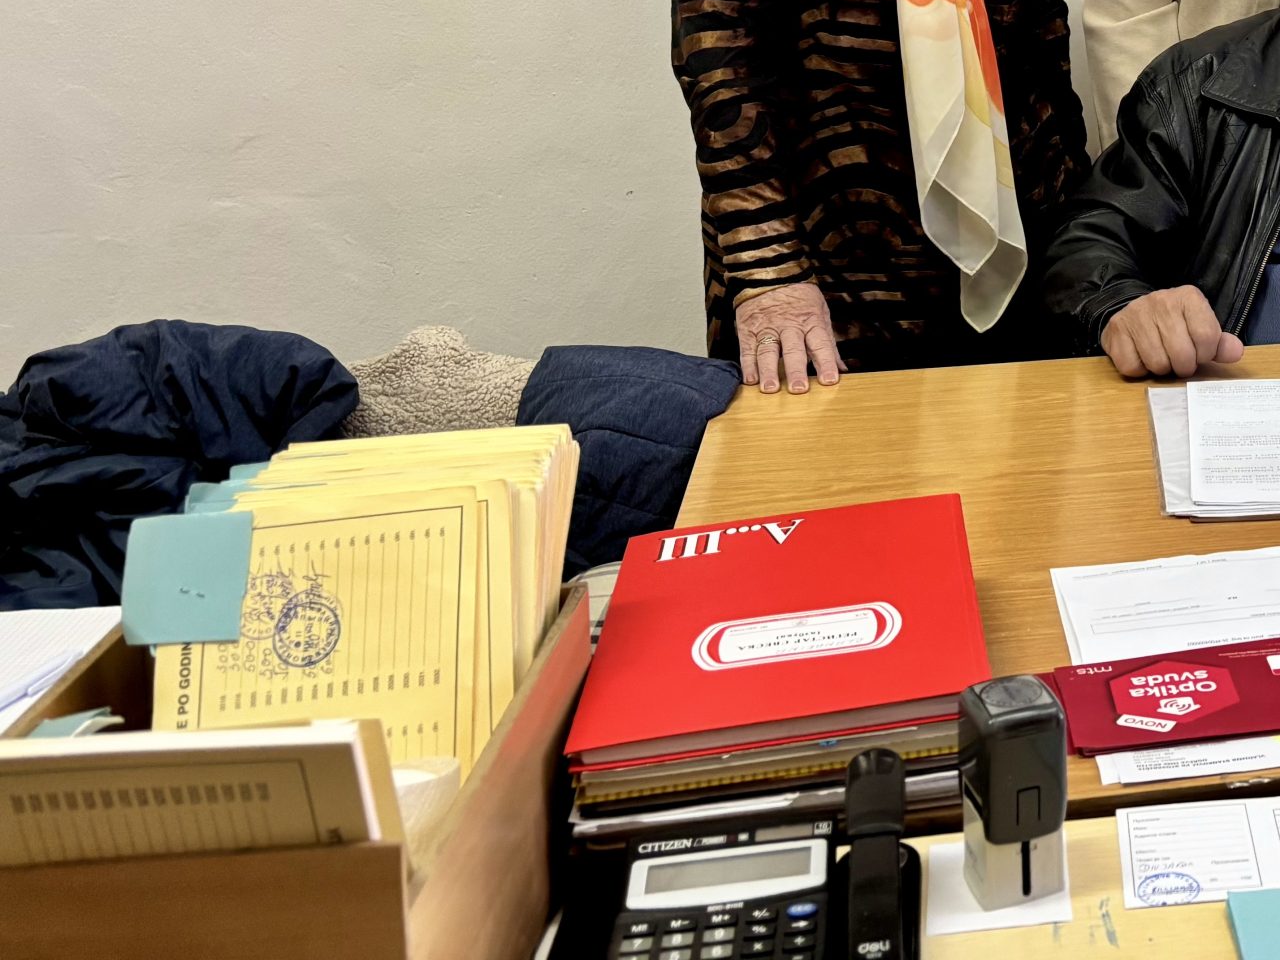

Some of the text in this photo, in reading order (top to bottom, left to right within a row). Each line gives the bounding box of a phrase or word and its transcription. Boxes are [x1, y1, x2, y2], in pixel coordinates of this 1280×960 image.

[179, 642, 192, 689] GODIN
[1075, 665, 1113, 676] mts
[1130, 669, 1208, 686] svuda
[1128, 680, 1217, 698] Optika
[177, 694, 190, 715] PO
[1124, 717, 1167, 730] NOVO
[638, 838, 693, 854] CITIZEN
[858, 939, 890, 954] deli
